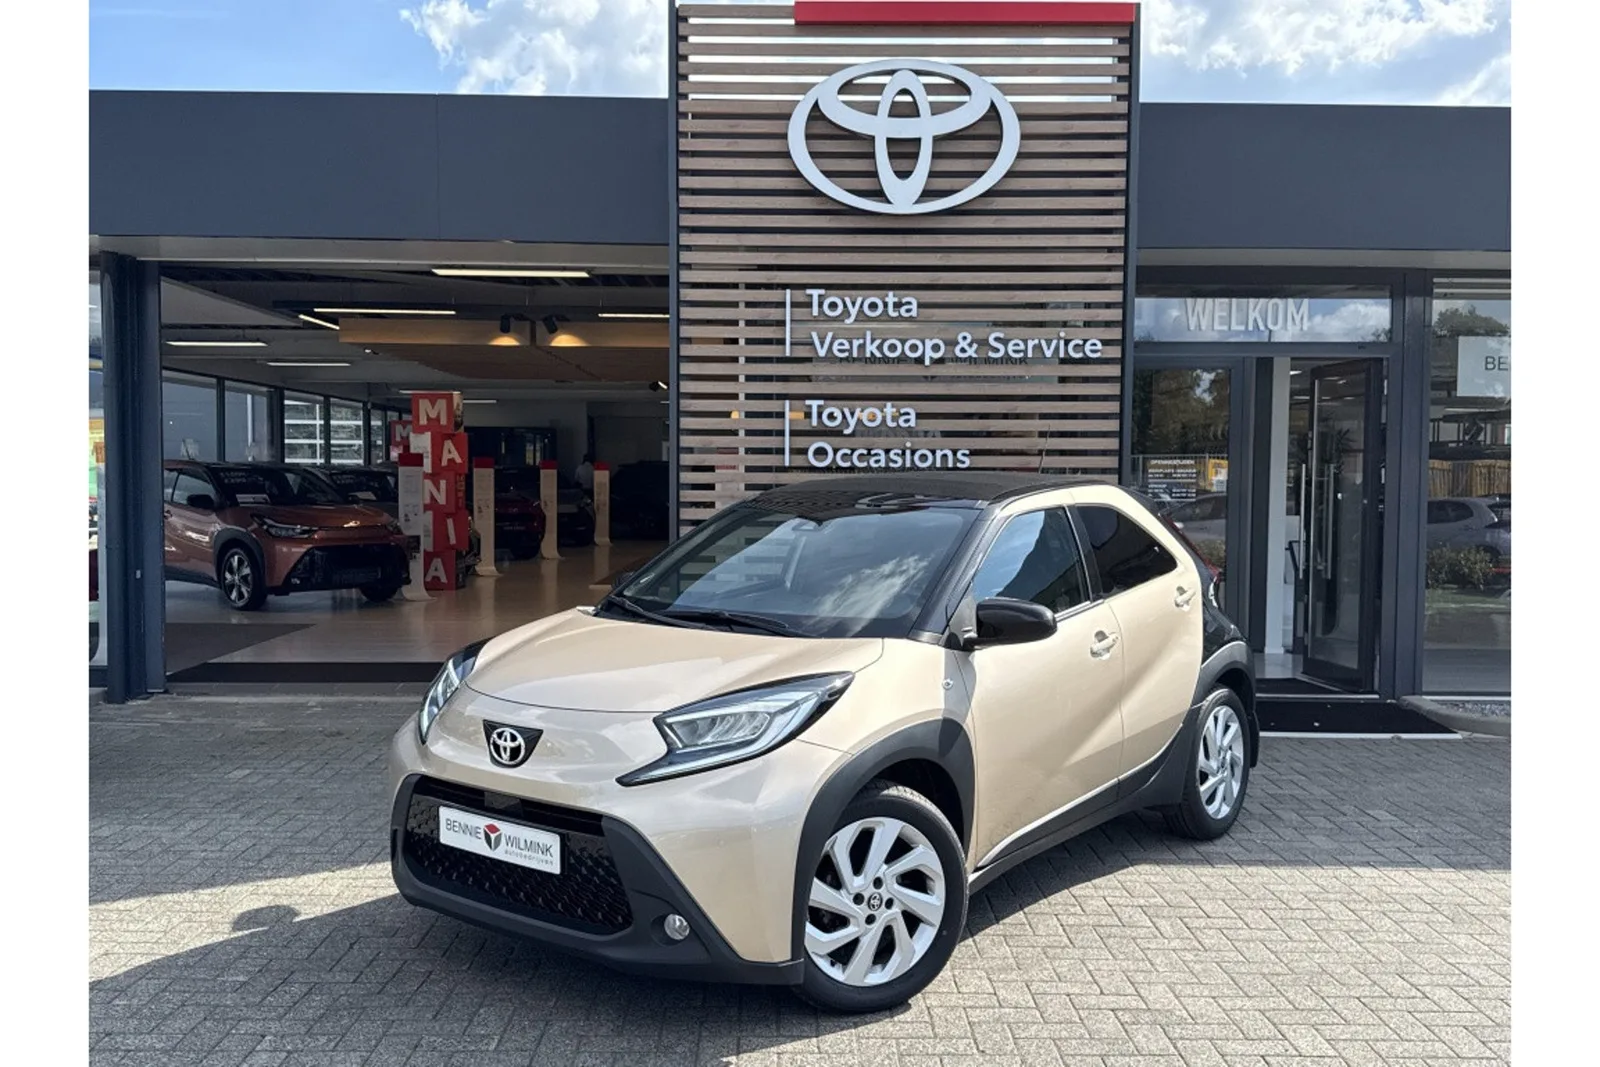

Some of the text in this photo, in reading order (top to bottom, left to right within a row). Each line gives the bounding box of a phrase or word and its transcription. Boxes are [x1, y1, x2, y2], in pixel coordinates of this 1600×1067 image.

[806, 288, 918, 325] Toyota
[1185, 297, 1310, 332] WELKOM
[811, 330, 1103, 366] Verkoop & Service
[805, 399, 917, 434] Toyota
[807, 440, 971, 469] Occasions
[445, 818, 553, 858] BENNIE WILMINK
